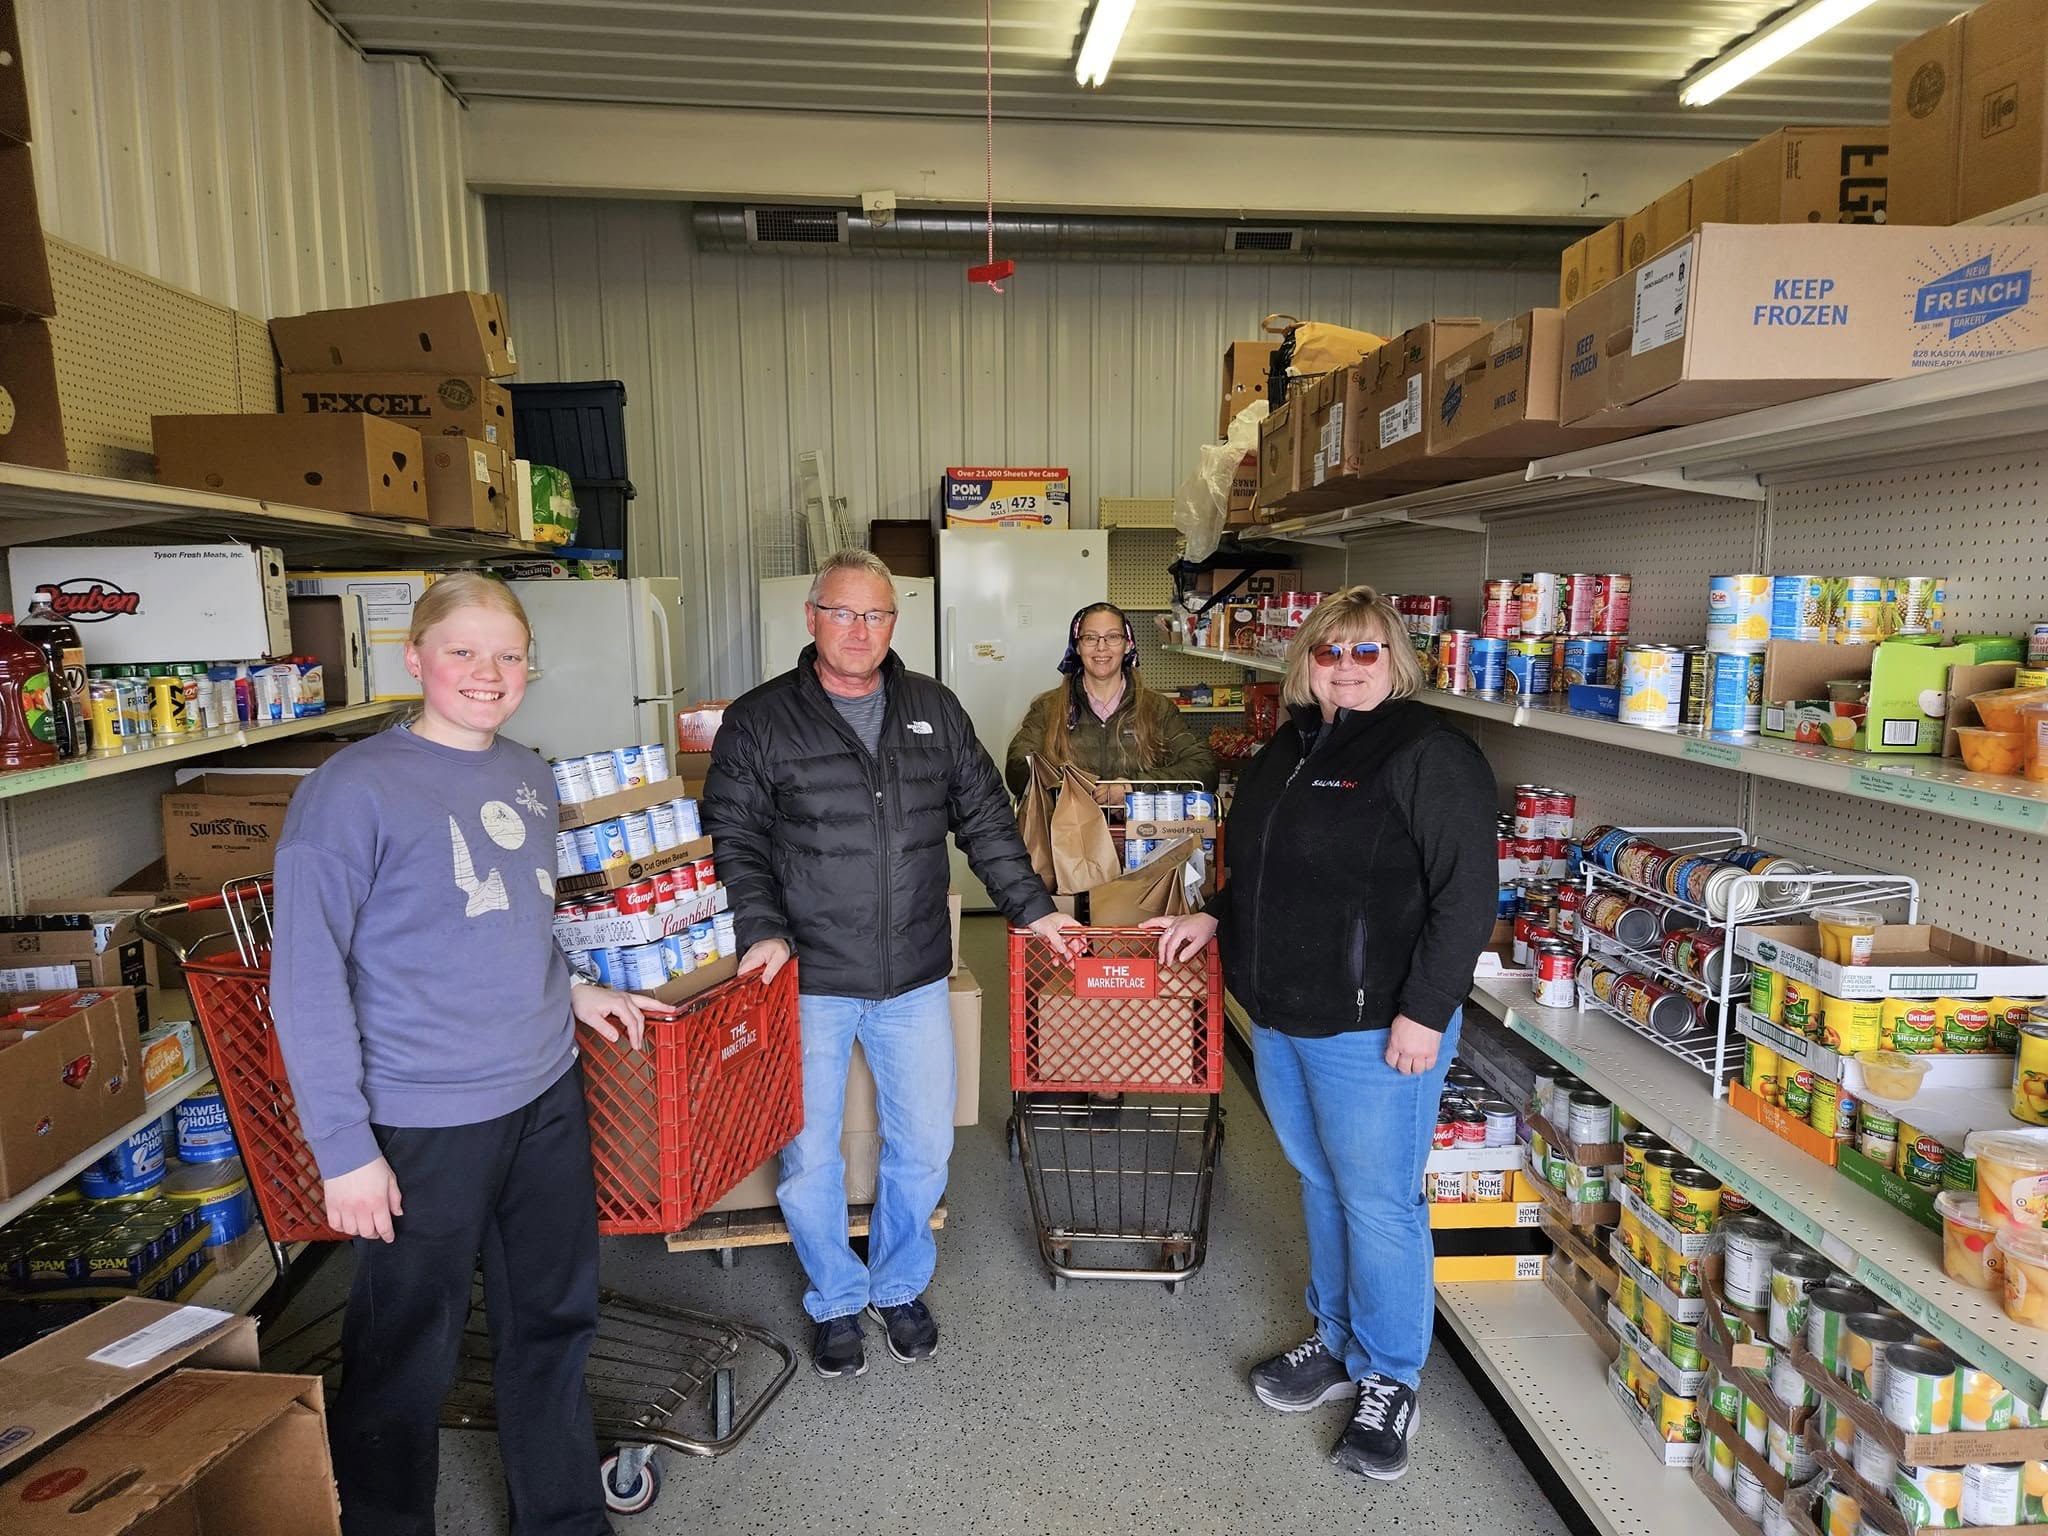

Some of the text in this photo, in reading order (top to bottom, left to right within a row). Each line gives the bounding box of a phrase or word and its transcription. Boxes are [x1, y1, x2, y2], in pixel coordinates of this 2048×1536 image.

[1966, 264, 1989, 278] NEW
[1774, 279, 1834, 300] KEEP
[1924, 280, 2022, 313] FRENCH
[1753, 305, 1848, 326] FROZEN
[1953, 314, 1987, 328] BAKERY
[1576, 334, 1595, 358] KEEP
[1930, 349, 1967, 358] KASOTA
[1570, 352, 1598, 380] FROZEN
[1911, 359, 1964, 368] MINNEAP
[302, 393, 432, 416] EXCEL
[976, 470, 1002, 478] 21,000
[951, 484, 981, 495] POM
[990, 500, 1002, 510] 45
[1011, 496, 1036, 508] 473
[154, 551, 177, 560] Tyson
[203, 551, 229, 559] Meats,
[1712, 592, 1727, 602] Dole
[189, 821, 231, 838] SWISS
[1514, 843, 1543, 854] ampbell's
[644, 851, 689, 871] Cut Green Beans
[1103, 966, 1130, 976] THE
[1087, 977, 1145, 989] MARKETPLACE
[1908, 1013, 1935, 1021] Del Mont
[1957, 1013, 1969, 1021] Del
[2007, 1012, 2019, 1020] Del
[730, 1020, 747, 1040] THE
[1897, 1034, 1919, 1042] Sliced
[1946, 1033, 1969, 1042] Sliced
[721, 1029, 758, 1061] MARKETPLACE
[1788, 1093, 1808, 1103] Sliced
[129, 1120, 163, 1148] MAXW
[1918, 1142, 1930, 1152] Del
[1551, 1167, 1566, 1179] PEA
[1913, 1168, 1931, 1178] Pear
[1437, 1179, 1461, 1188] HOME
[1478, 1179, 1501, 1188] HOME
[1437, 1187, 1461, 1196] STYLE
[1477, 1187, 1501, 1196] STYLE
[1519, 1208, 1540, 1217] HOME
[1518, 1215, 1540, 1223] STYLE
[30, 1260, 66, 1271] SPAM
[89, 1257, 128, 1270] SPAM
[1518, 1261, 1540, 1269] HOME
[1866, 1268, 1881, 1283] Fruit
[1720, 1391, 1738, 1404] PEA
